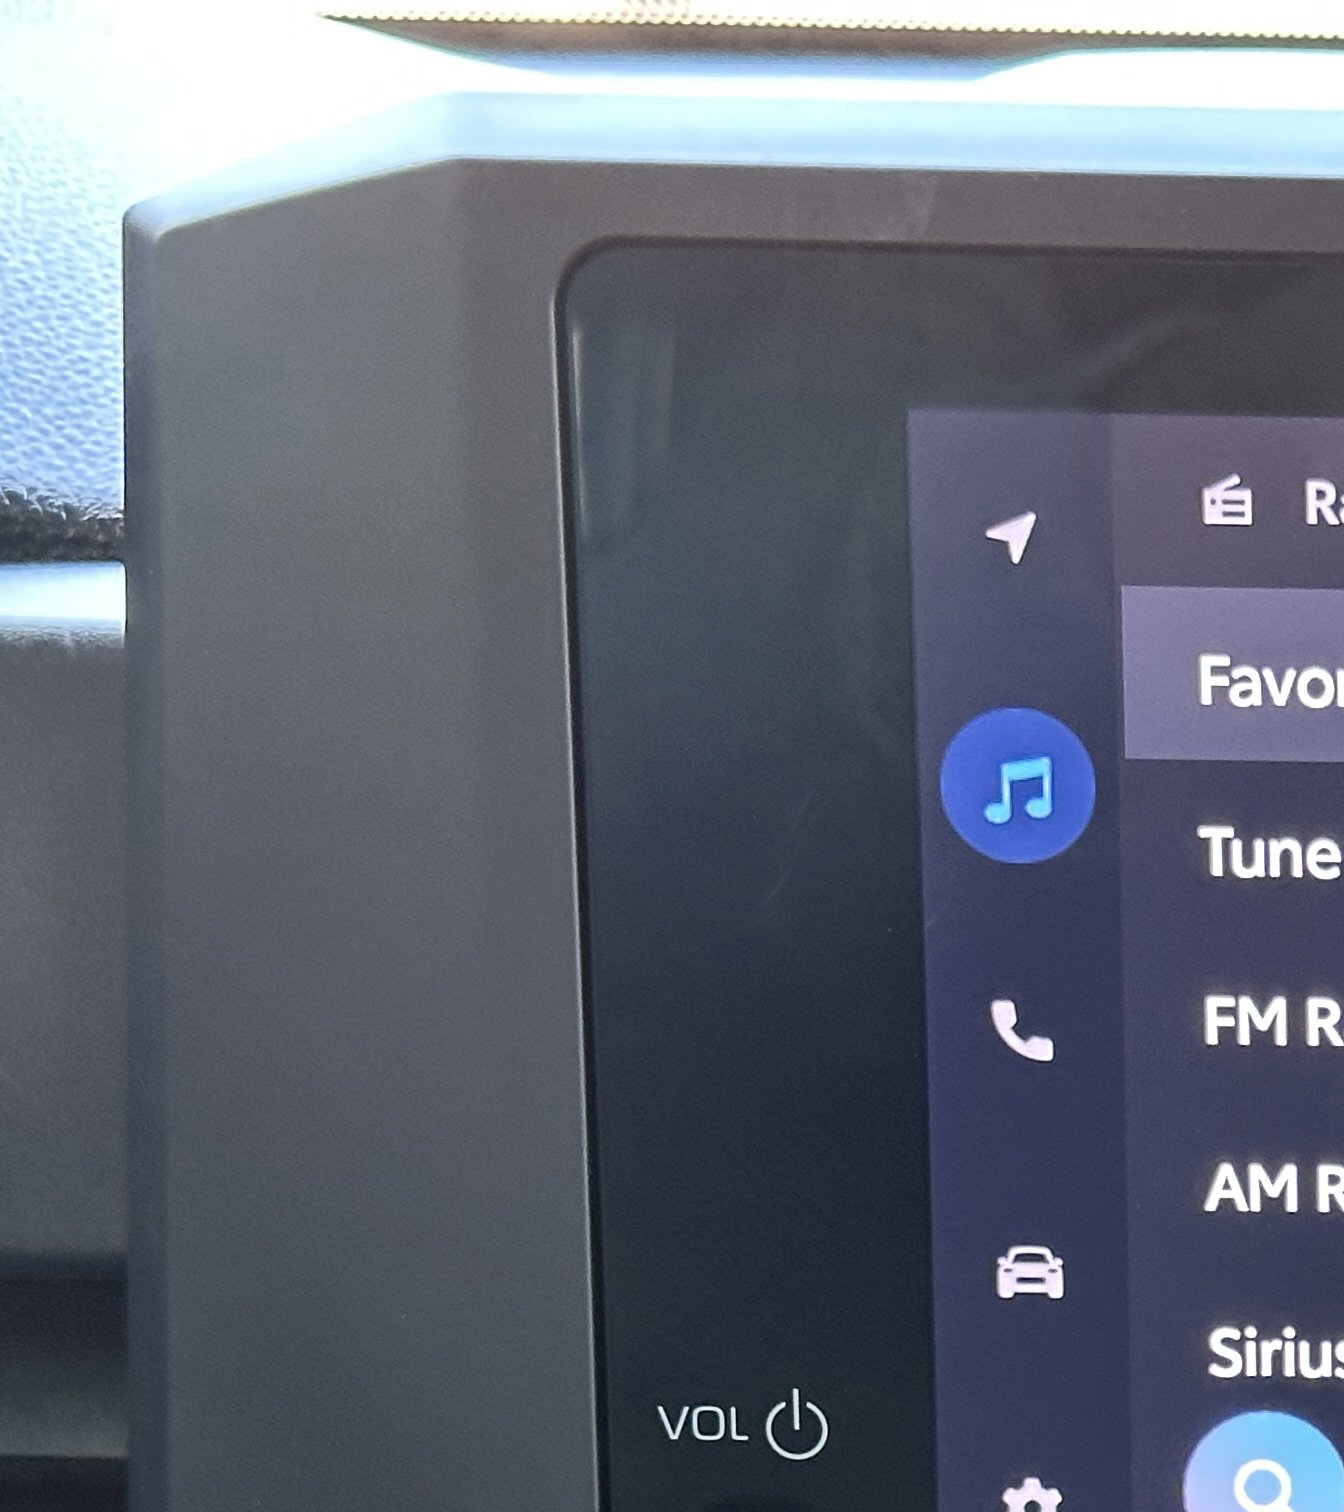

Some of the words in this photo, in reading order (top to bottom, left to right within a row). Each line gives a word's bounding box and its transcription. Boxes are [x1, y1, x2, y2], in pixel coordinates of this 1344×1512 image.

[1196, 825, 1342, 880] Tune
[1204, 994, 1288, 1047] FM
[1203, 1161, 1299, 1213] AM
[657, 1405, 749, 1441] VOL
